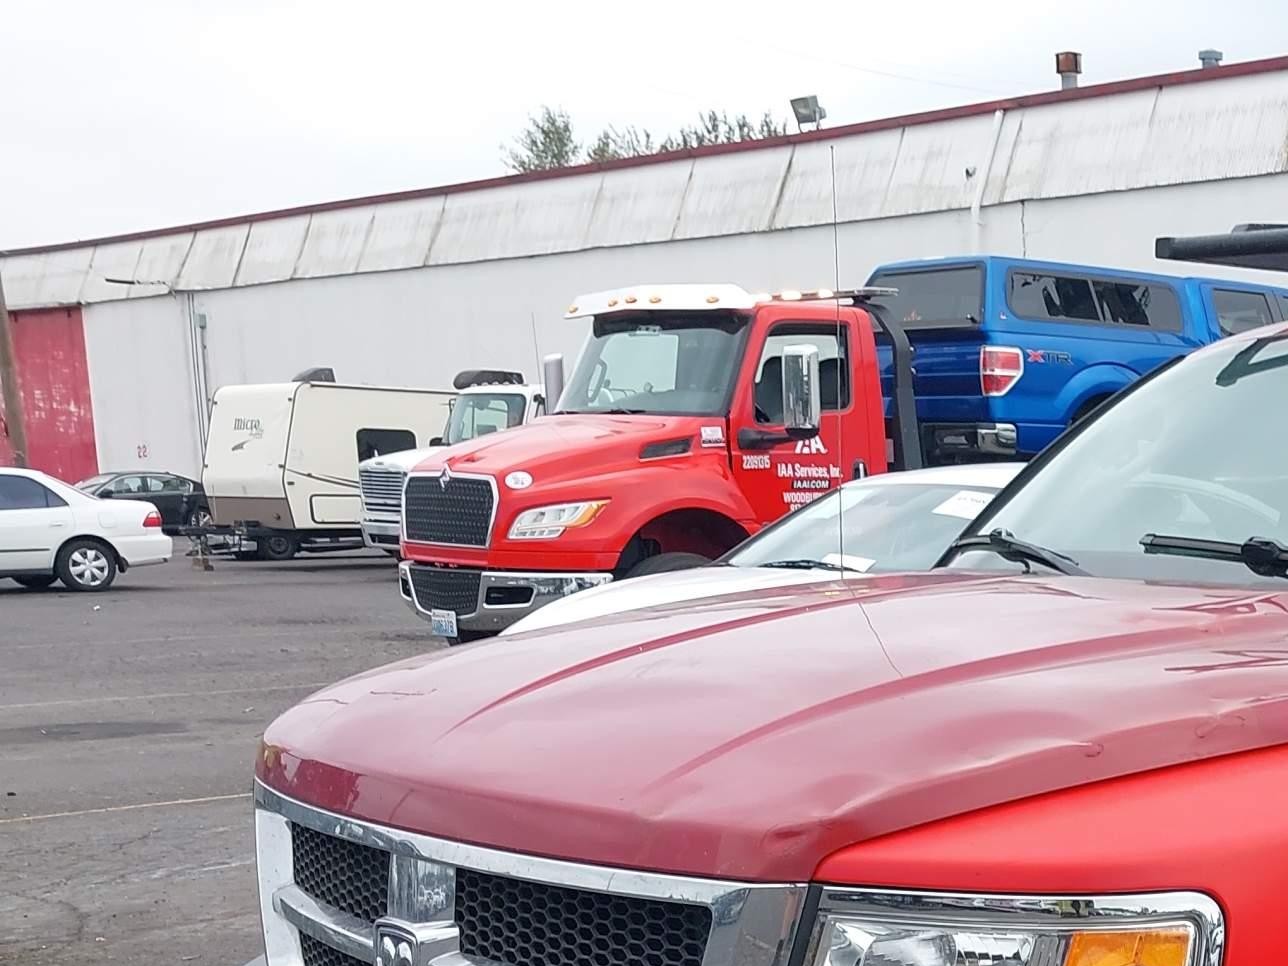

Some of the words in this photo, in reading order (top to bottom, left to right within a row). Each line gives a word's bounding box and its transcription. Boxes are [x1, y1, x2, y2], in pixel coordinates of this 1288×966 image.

[1025, 349, 1074, 365] XTR
[777, 463, 794, 478] IAA
[794, 463, 829, 479] Services,
